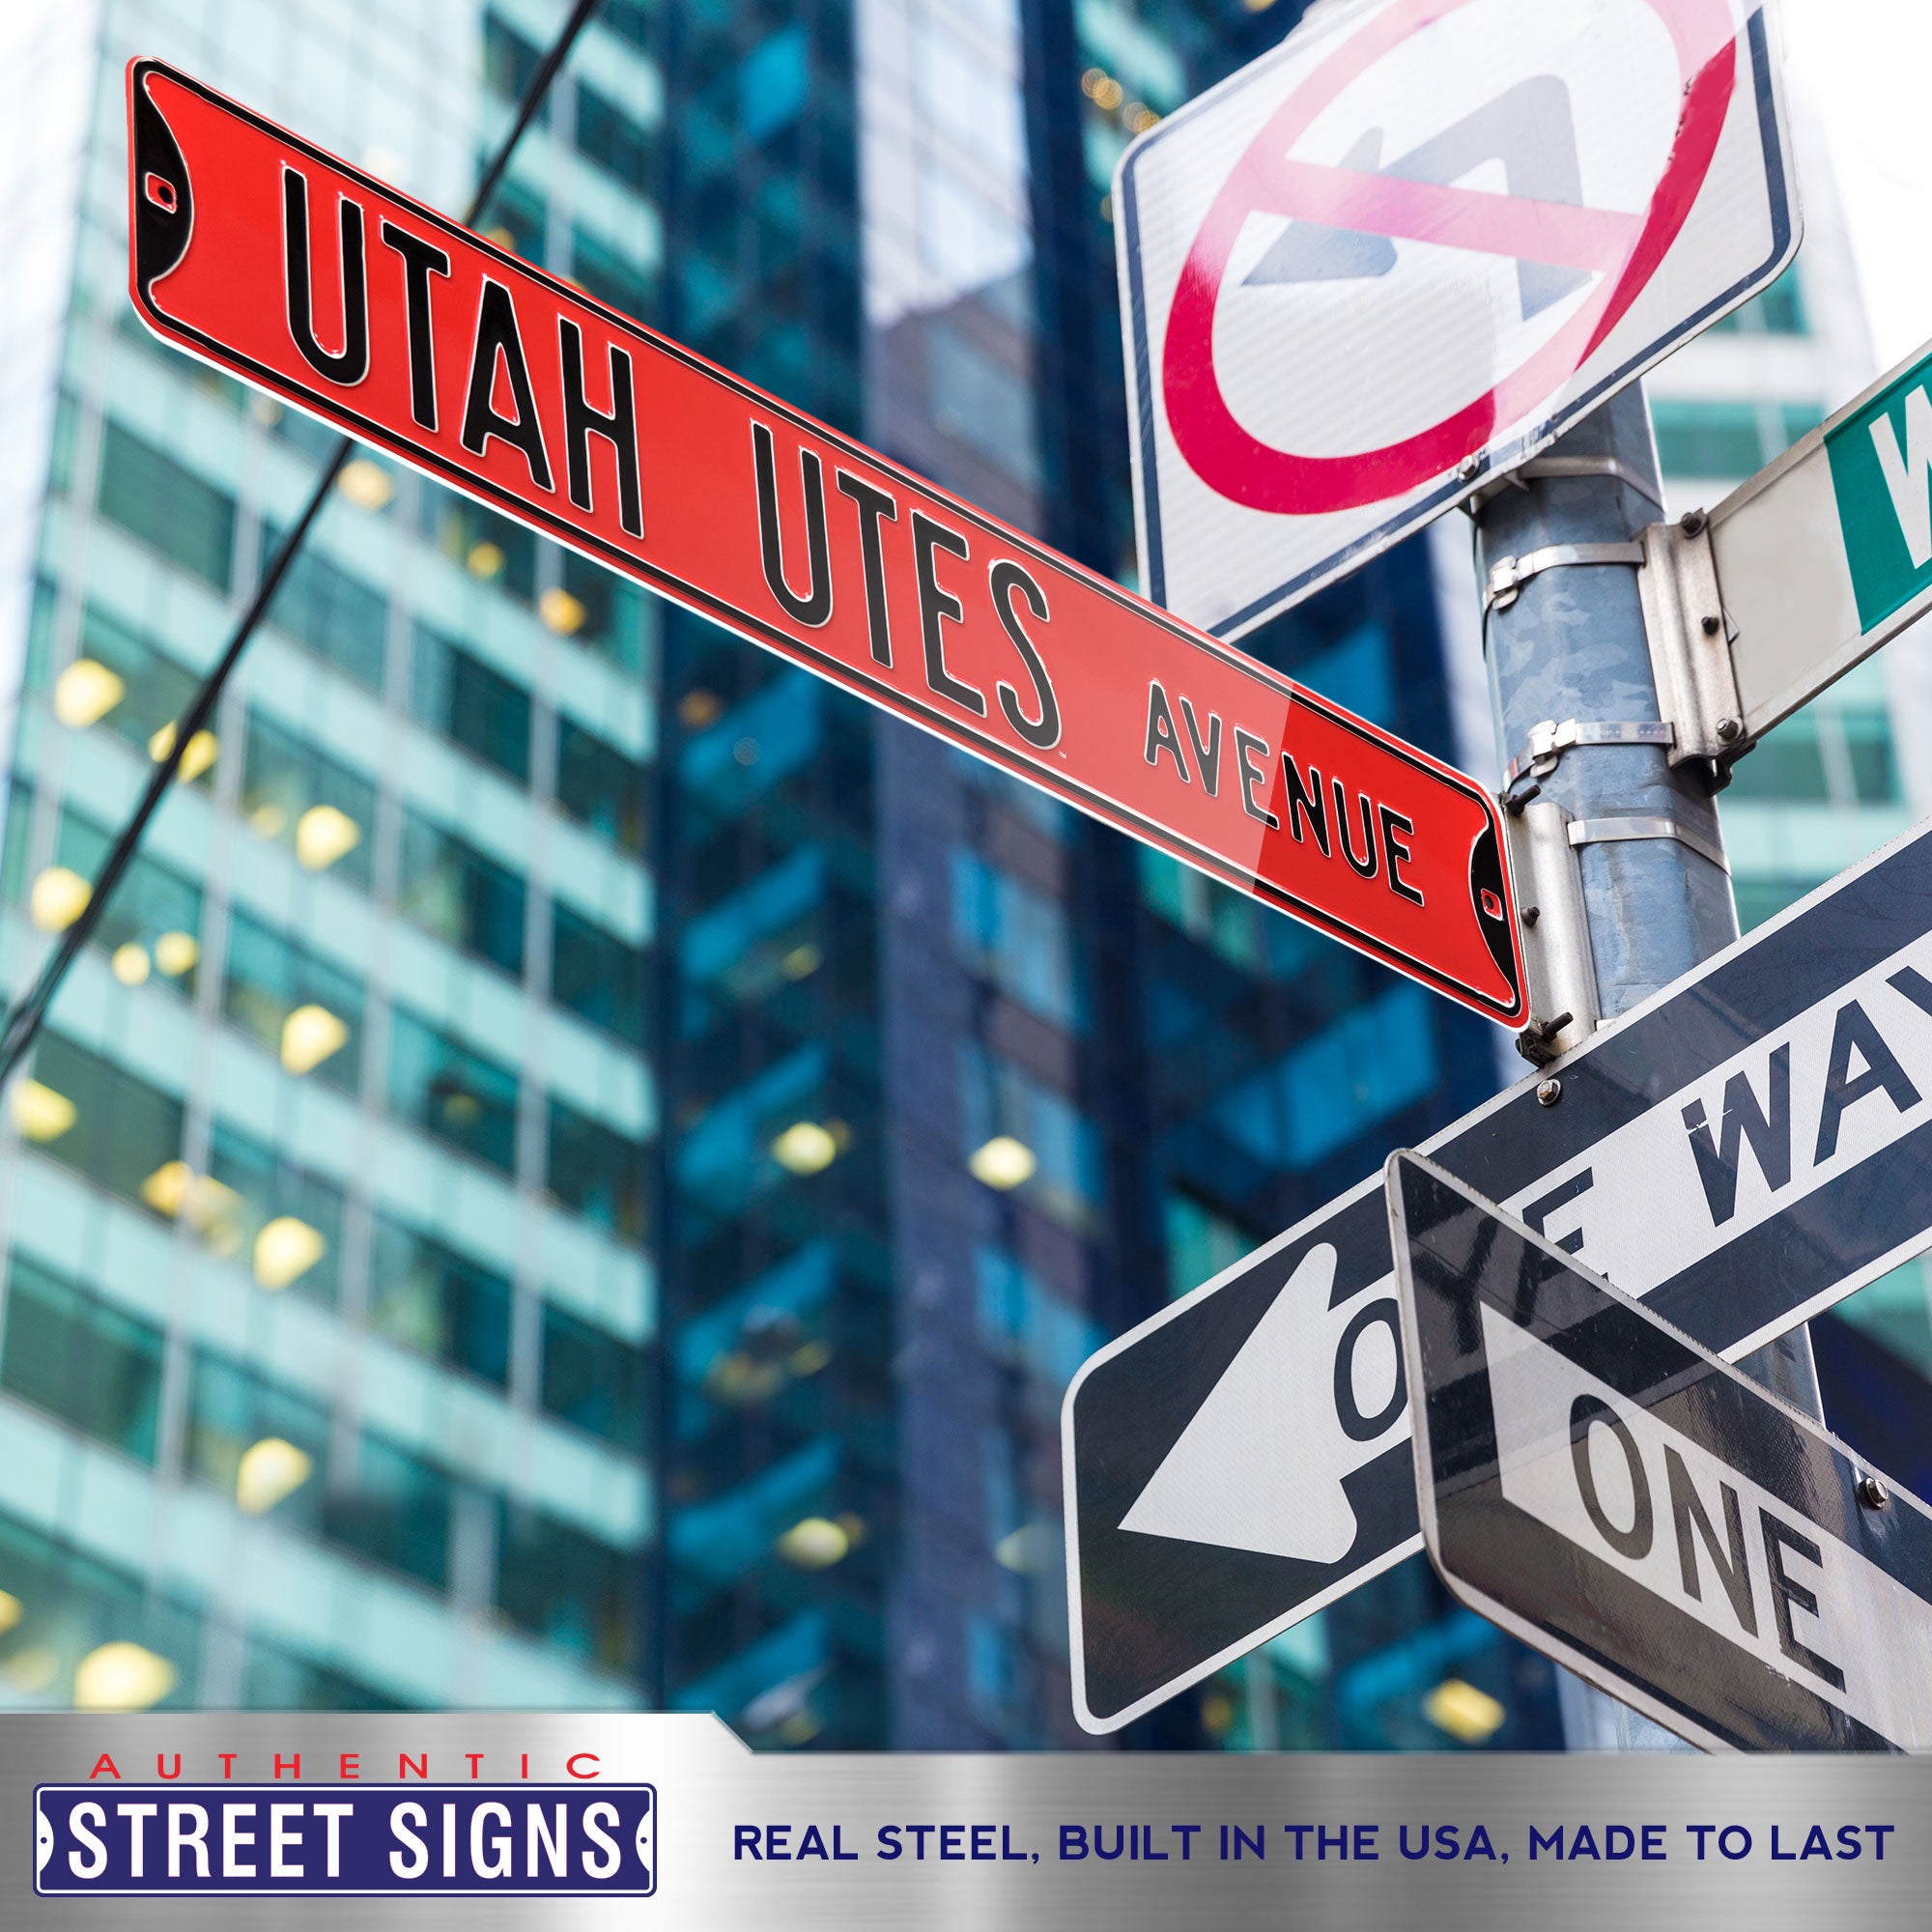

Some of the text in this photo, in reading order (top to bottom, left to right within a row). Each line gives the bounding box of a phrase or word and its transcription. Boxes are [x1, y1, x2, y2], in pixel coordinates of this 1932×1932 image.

[281, 160, 644, 541] UTAH
[750, 418, 1062, 751] UTES
[1143, 678, 1425, 909] AVENUE
[1569, 1393, 1847, 1694] ONE
